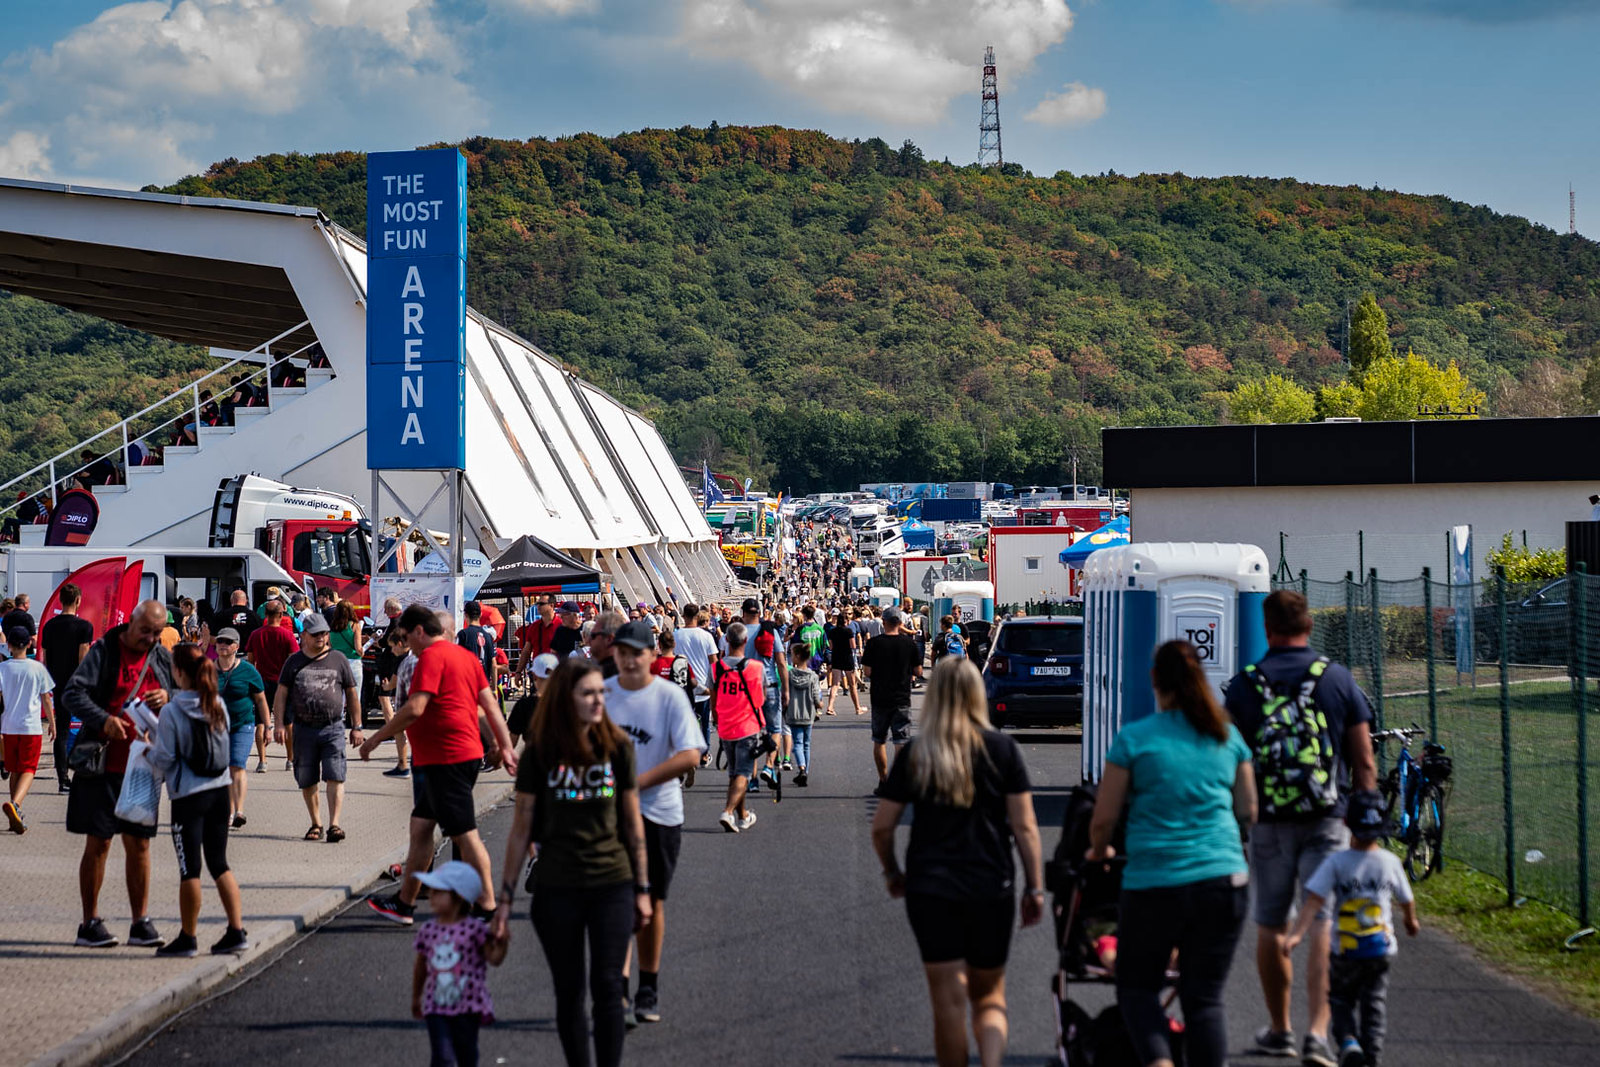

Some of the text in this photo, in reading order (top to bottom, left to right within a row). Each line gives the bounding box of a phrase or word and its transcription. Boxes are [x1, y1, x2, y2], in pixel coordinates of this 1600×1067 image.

[382, 174, 425, 195] THE
[383, 200, 443, 223] MOST
[383, 229, 426, 250] FUN
[400, 265, 426, 445] ARENA
[283, 497, 340, 511] www.diplo.cz
[497, 561, 563, 571] MOST DRIVING
[1196, 645, 1214, 660] OI
